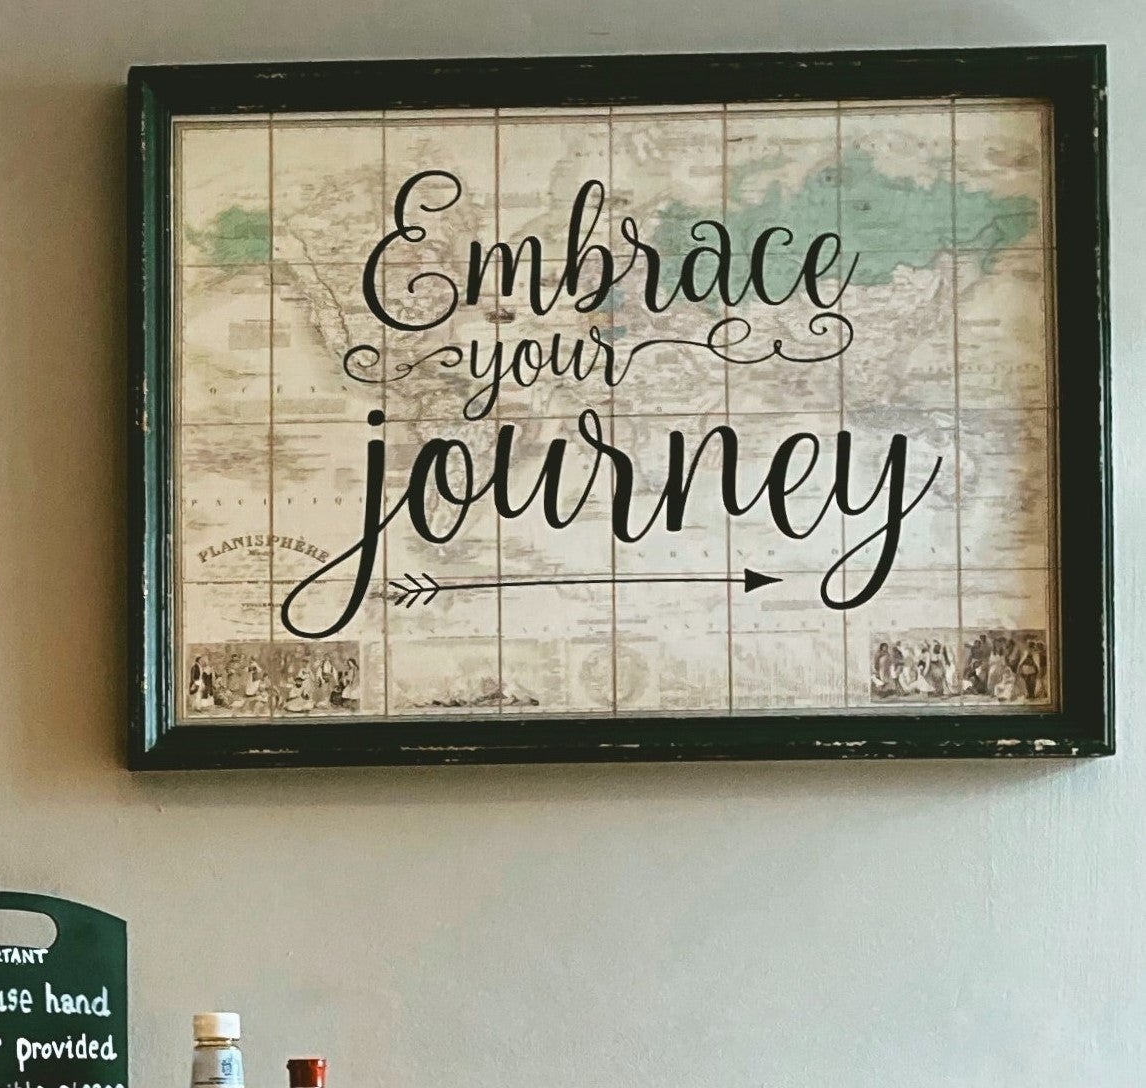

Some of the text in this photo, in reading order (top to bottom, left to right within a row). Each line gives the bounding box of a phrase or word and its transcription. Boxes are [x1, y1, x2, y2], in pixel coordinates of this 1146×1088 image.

[362, 169, 859, 331] Embrace
[462, 325, 634, 422] your
[281, 408, 944, 639] journey
[44, 981, 112, 1017] hand
[16, 1033, 118, 1072] provided
